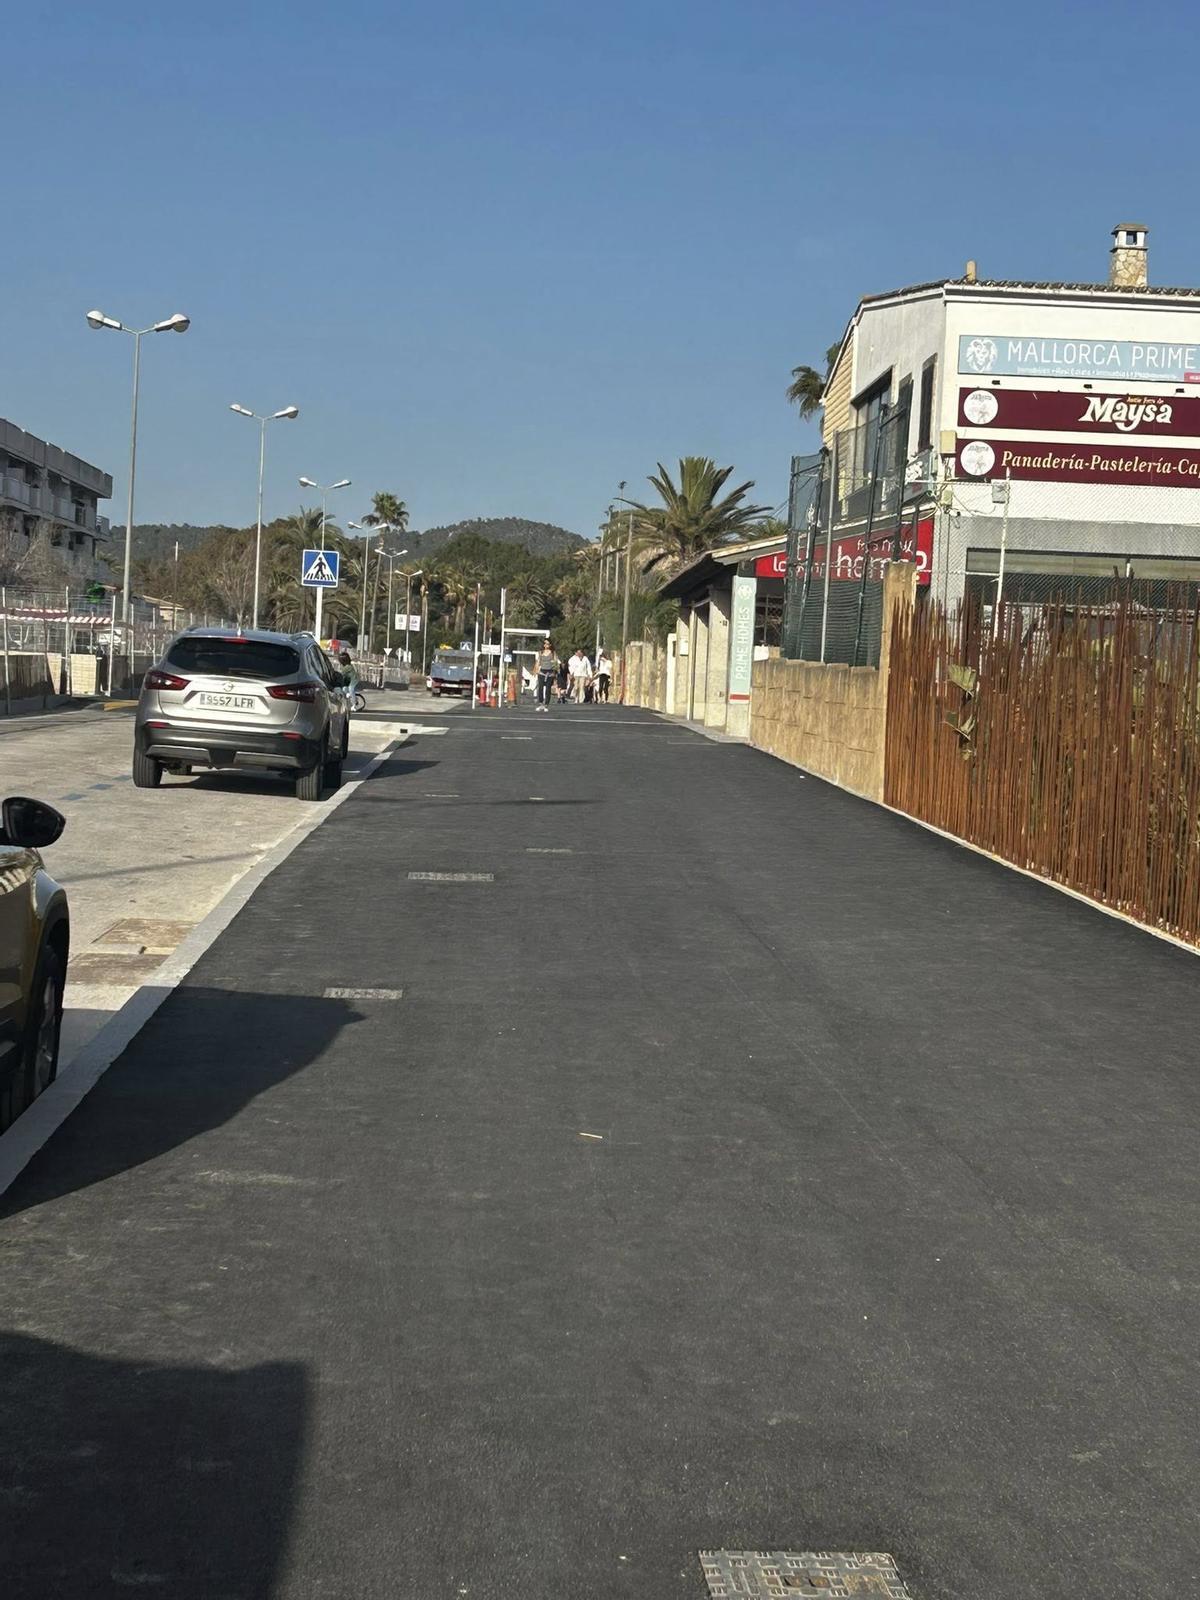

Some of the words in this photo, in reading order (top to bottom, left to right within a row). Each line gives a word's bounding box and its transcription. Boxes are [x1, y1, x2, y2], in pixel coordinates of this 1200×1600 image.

[1007, 341, 1121, 367] MALLORCA
[1131, 345, 1197, 369] PRIME
[1078, 396, 1173, 432] Maysa
[1001, 450, 1200, 479] Panadería-Pastelería-Ca
[735, 645, 748, 680] PRIME
[234, 697, 254, 708] LFR
